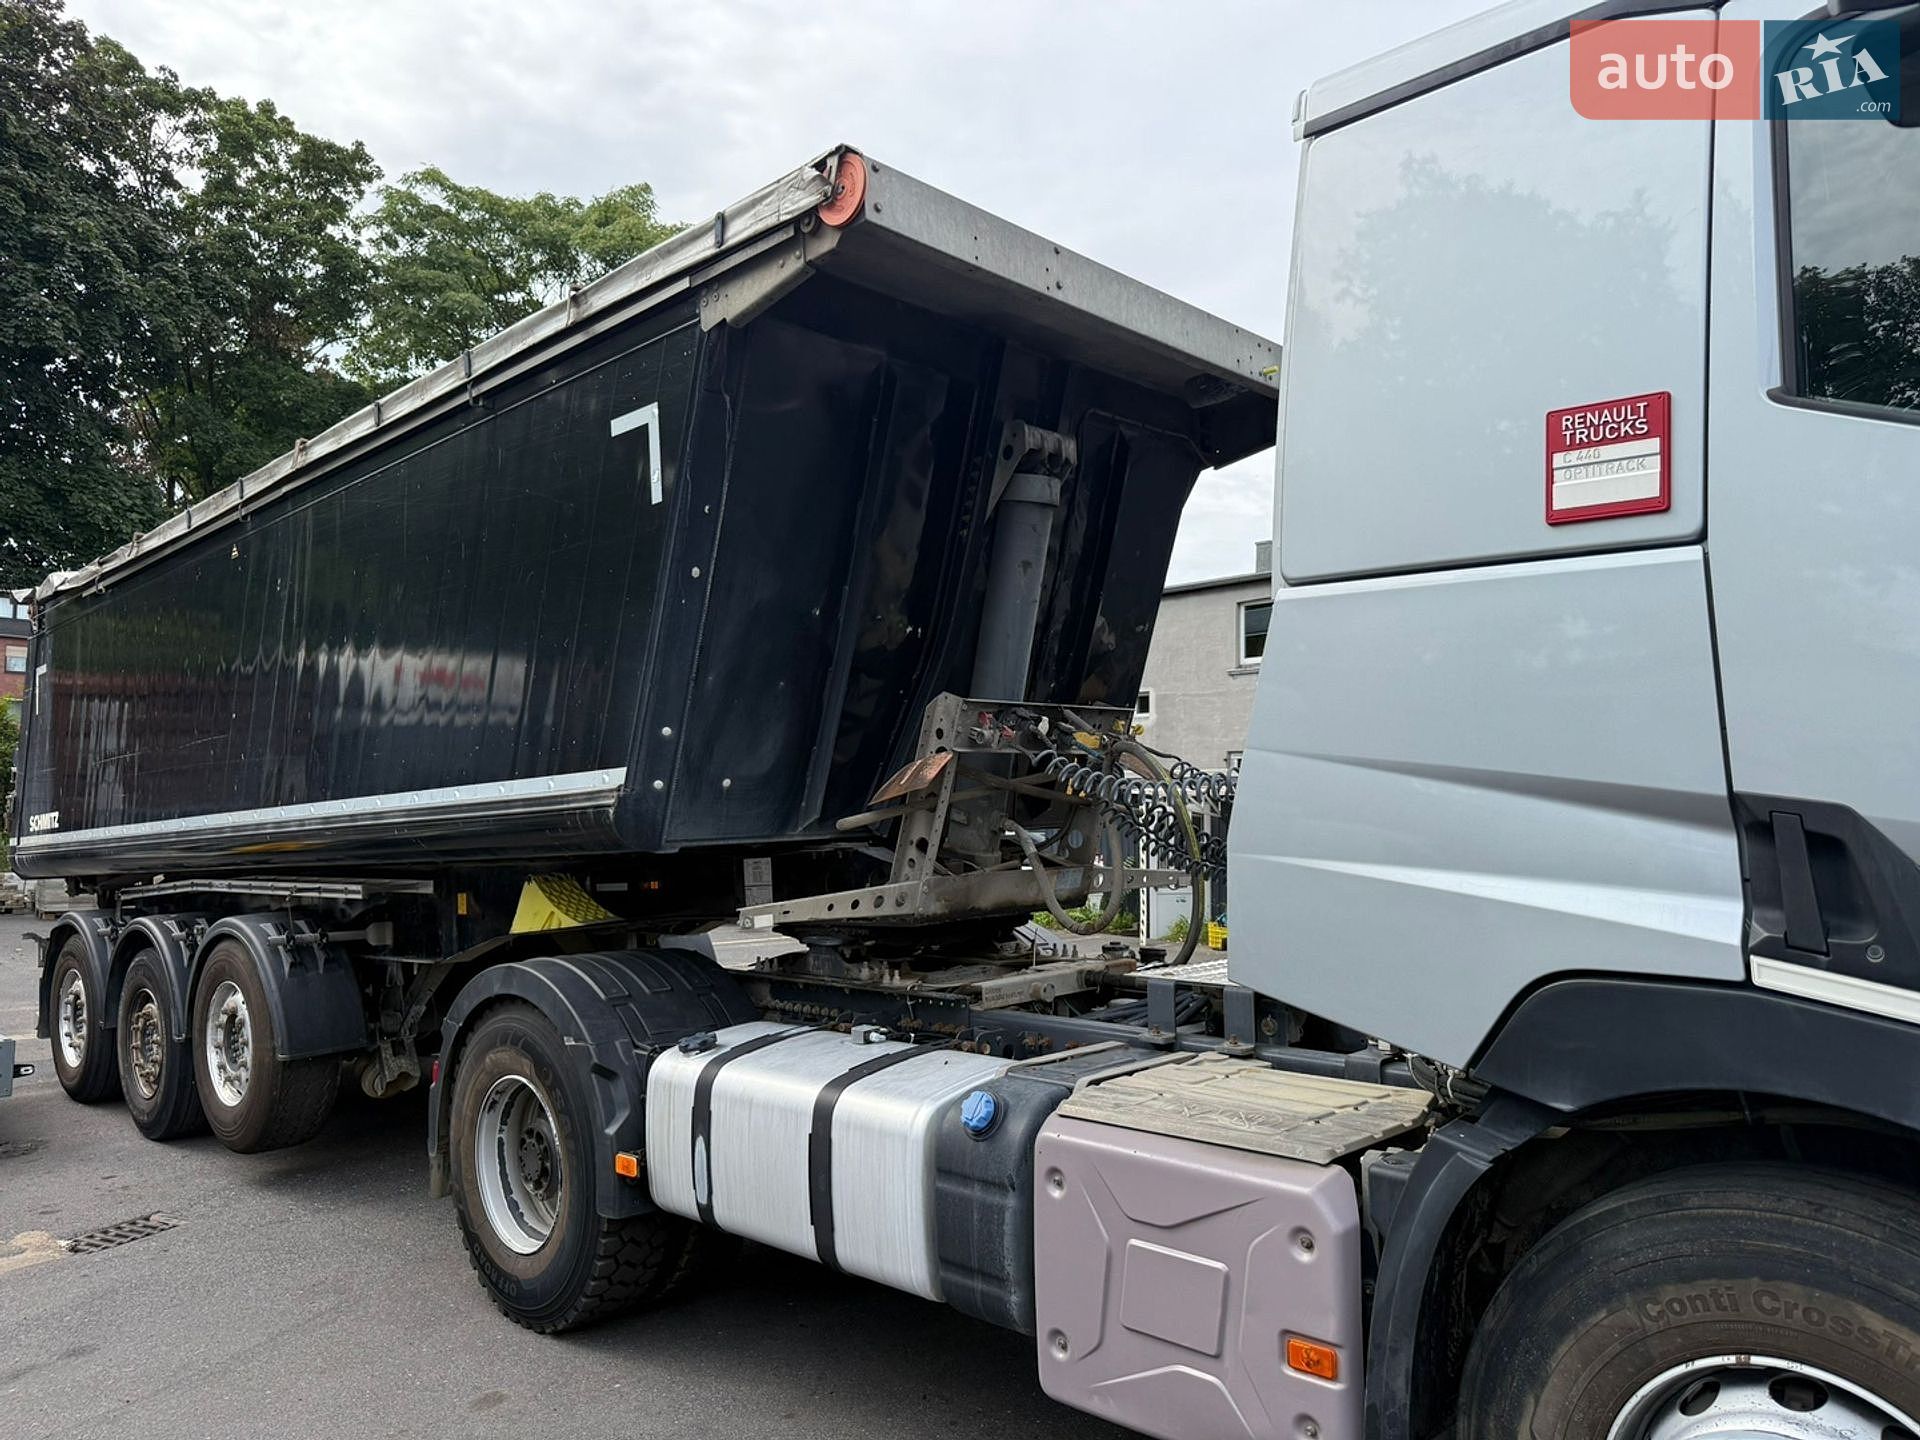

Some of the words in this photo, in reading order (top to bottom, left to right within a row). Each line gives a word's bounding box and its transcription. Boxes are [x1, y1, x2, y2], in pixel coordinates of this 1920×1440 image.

[1562, 402, 1648, 430] RENAULT
[1562, 419, 1648, 446] TRUCKS
[1563, 451, 1572, 464] C
[1563, 458, 1648, 481] OPTITRACK
[1643, 1286, 1740, 1323] Conti
